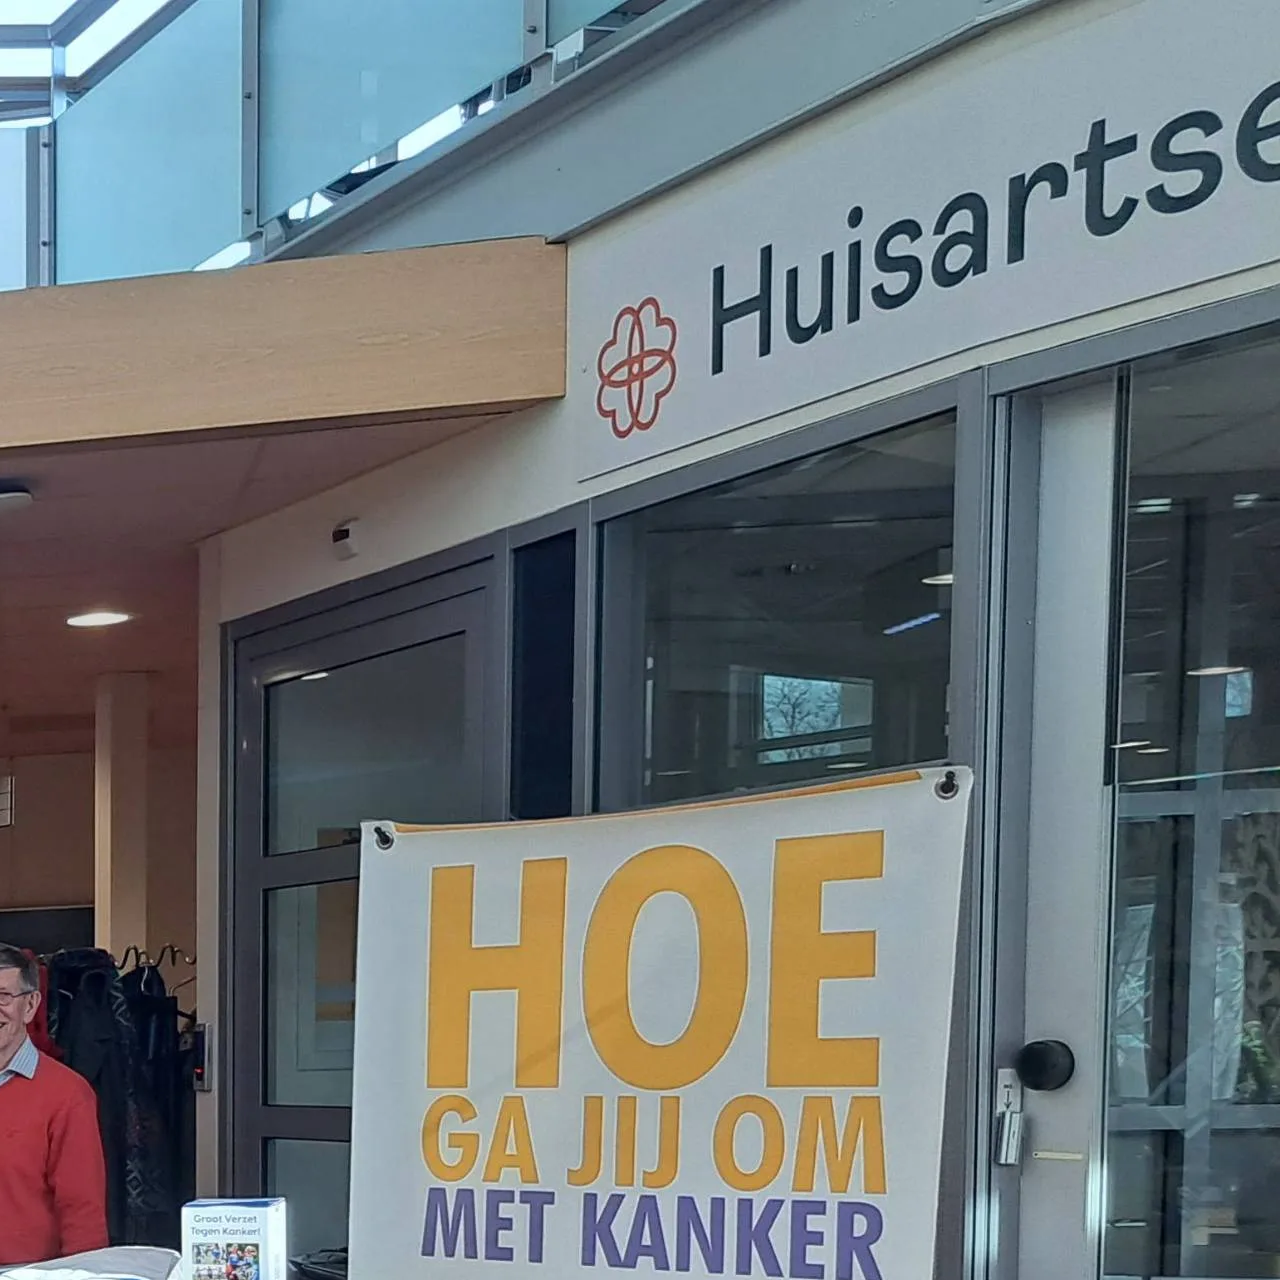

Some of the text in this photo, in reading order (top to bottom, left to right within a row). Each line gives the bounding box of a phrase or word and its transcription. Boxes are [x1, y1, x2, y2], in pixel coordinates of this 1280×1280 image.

[426, 829, 885, 1091] HOE
[421, 1093, 888, 1195] GA JIJ OM
[191, 1227, 220, 1237] Tegen
[193, 1214, 257, 1224] Groot Verzet
[421, 1186, 555, 1264] MET
